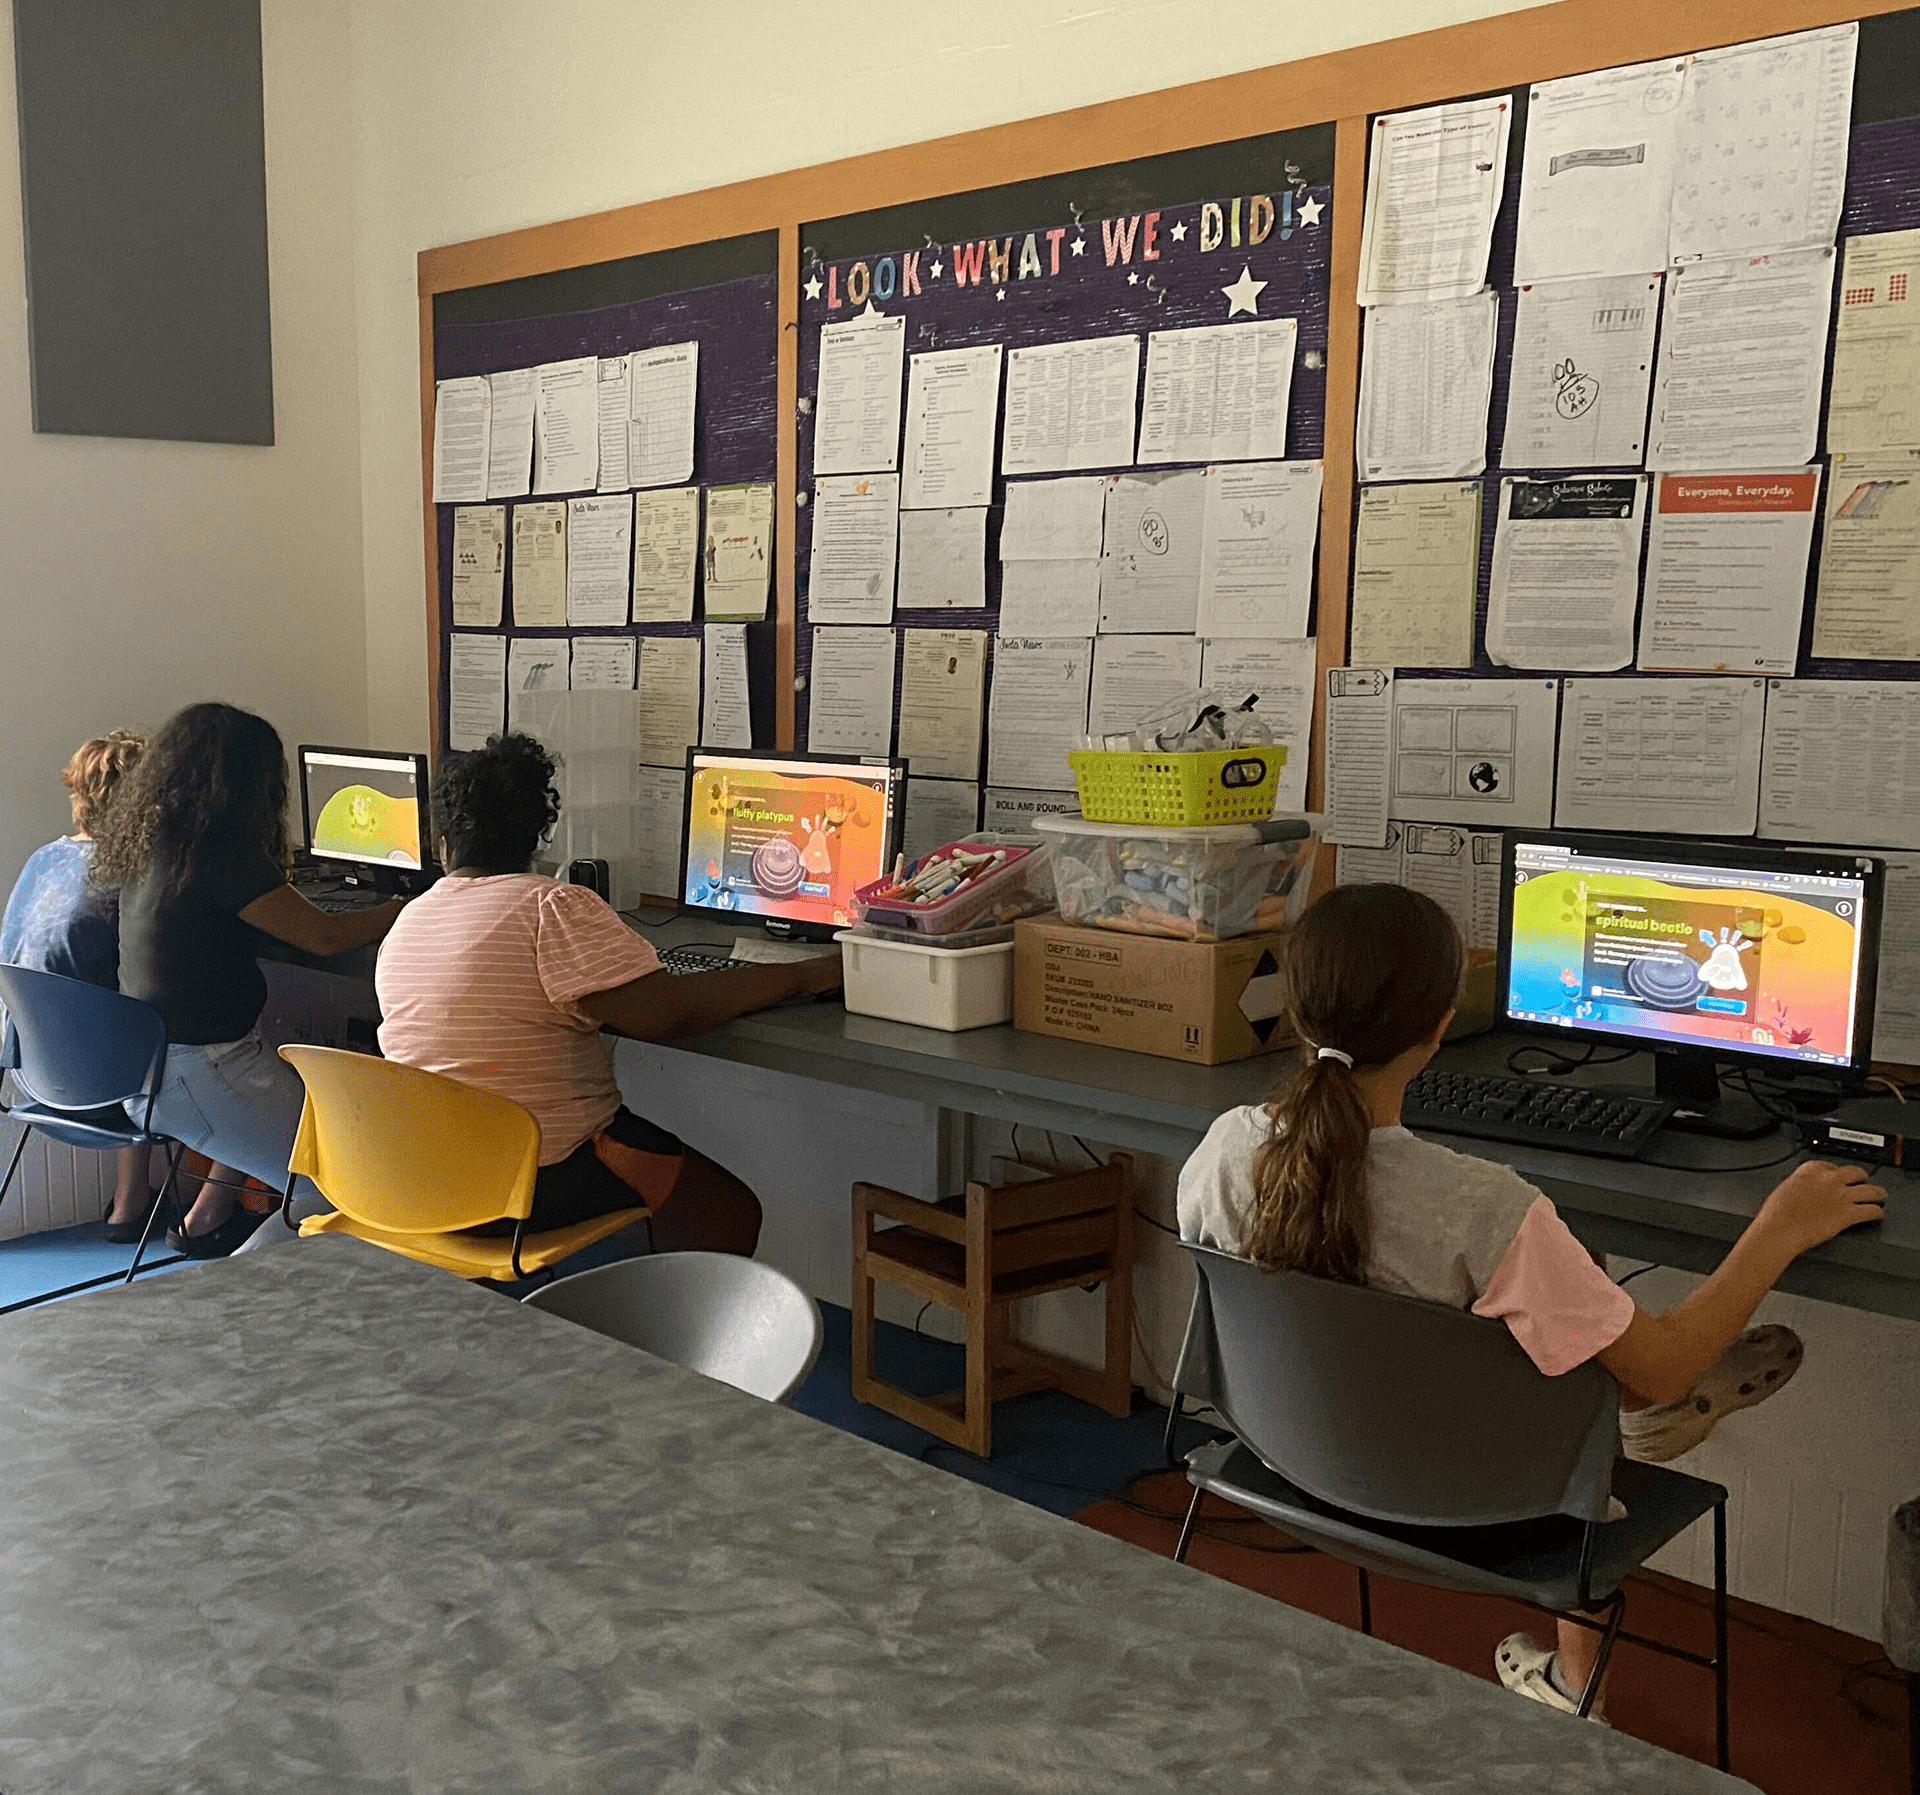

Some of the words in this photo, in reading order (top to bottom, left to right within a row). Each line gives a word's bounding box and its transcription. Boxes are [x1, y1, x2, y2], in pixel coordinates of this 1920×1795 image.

[828, 251, 922, 310] LOOK
[953, 228, 1066, 288] WHAT
[1102, 212, 1160, 267] WE
[1201, 190, 1294, 253] DID!
[1677, 486, 1733, 499] Everyone,
[1736, 484, 1795, 498] Everyday.
[1021, 638, 1043, 649] News
[996, 800, 1016, 810] ROLL
[1017, 802, 1035, 811] AND
[1036, 803, 1066, 813] ROUND
[733, 807, 755, 820] fluffy
[756, 809, 794, 823] platypus
[1596, 916, 1649, 930] spiritual
[1075, 947, 1091, 958] 002
[1098, 951, 1120, 962] HBA
[1070, 999, 1088, 1010] Case
[1089, 990, 1113, 1002] HAND
[1113, 995, 1158, 1010] SANITIZER
[1045, 1016, 1063, 1026] Made
[1076, 1021, 1100, 1033] CHINA
